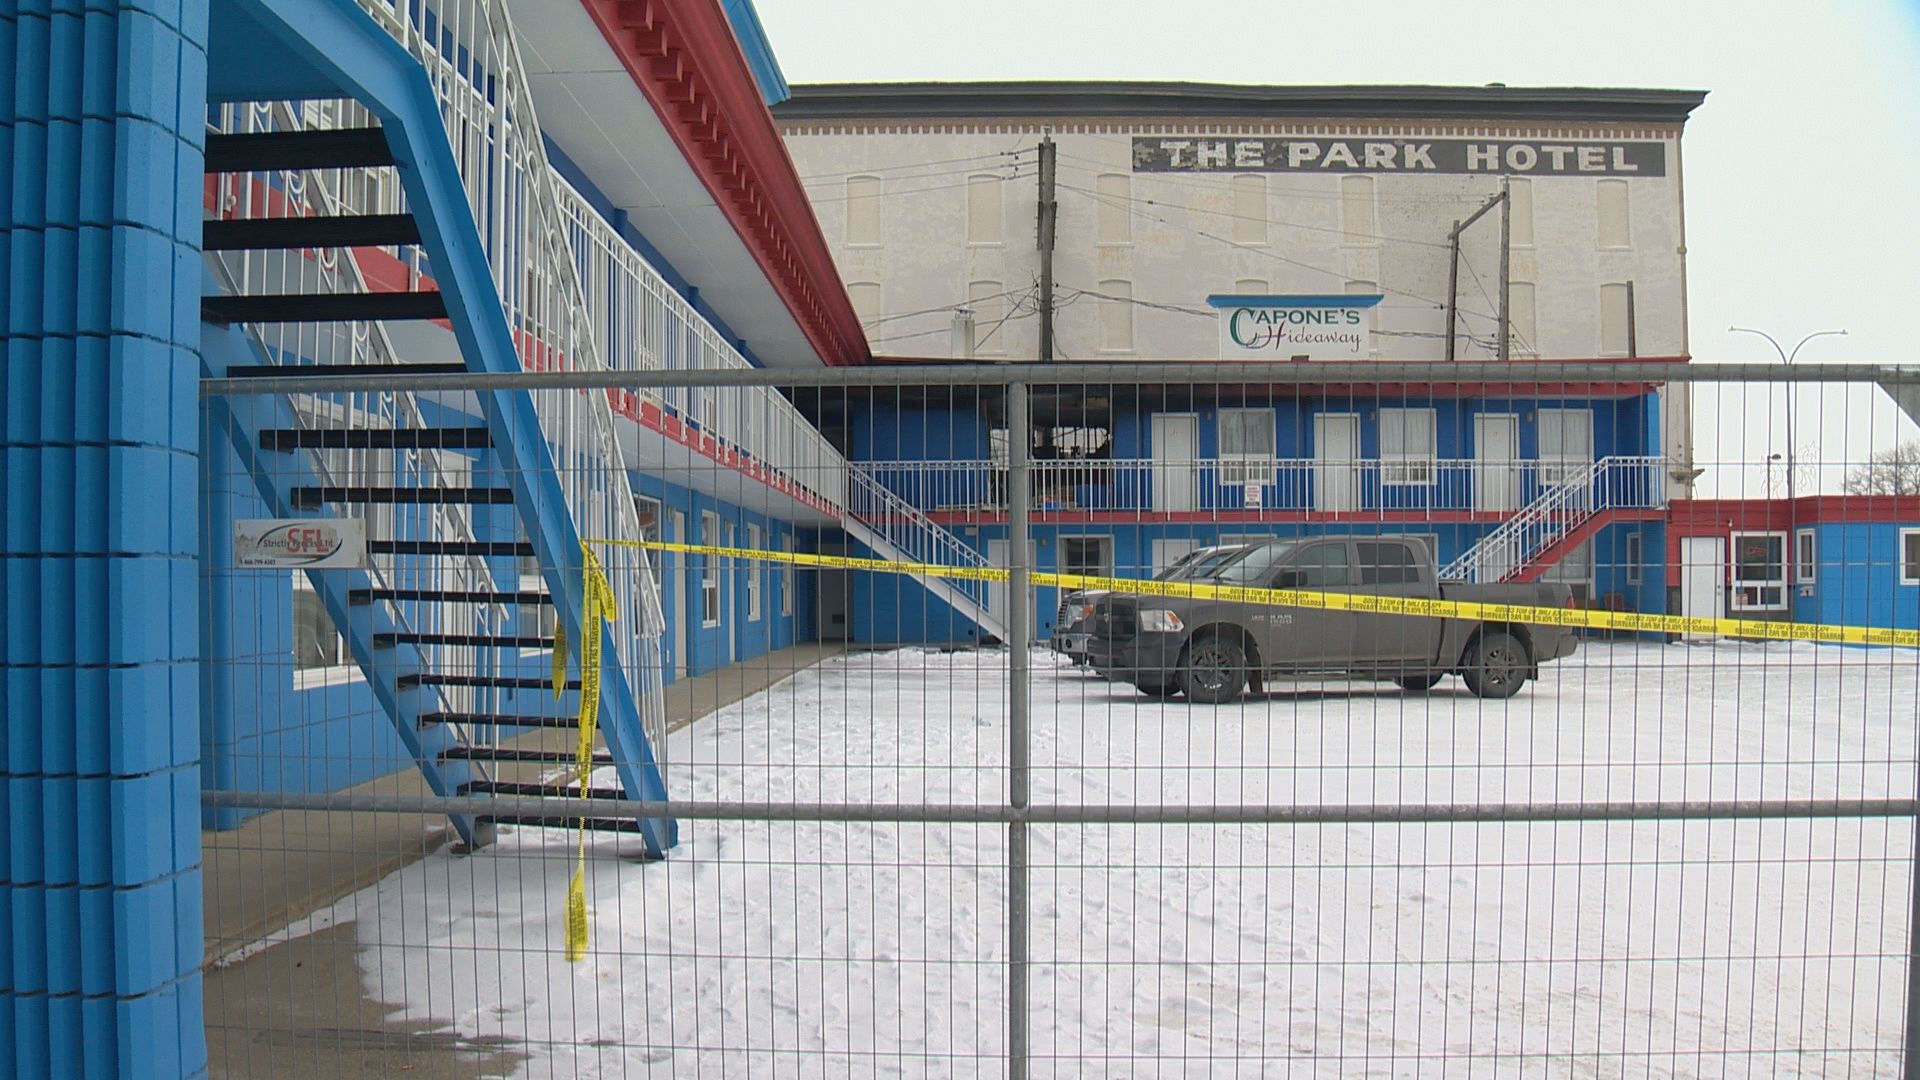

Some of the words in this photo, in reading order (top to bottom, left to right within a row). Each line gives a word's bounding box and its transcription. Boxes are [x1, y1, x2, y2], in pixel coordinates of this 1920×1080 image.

[1160, 141, 1264, 168] THE
[1288, 142, 1436, 170] PARK
[1466, 144, 1638, 171] HOTEL
[1246, 320, 1361, 352] Hideaway
[287, 528, 329, 553] SFL
